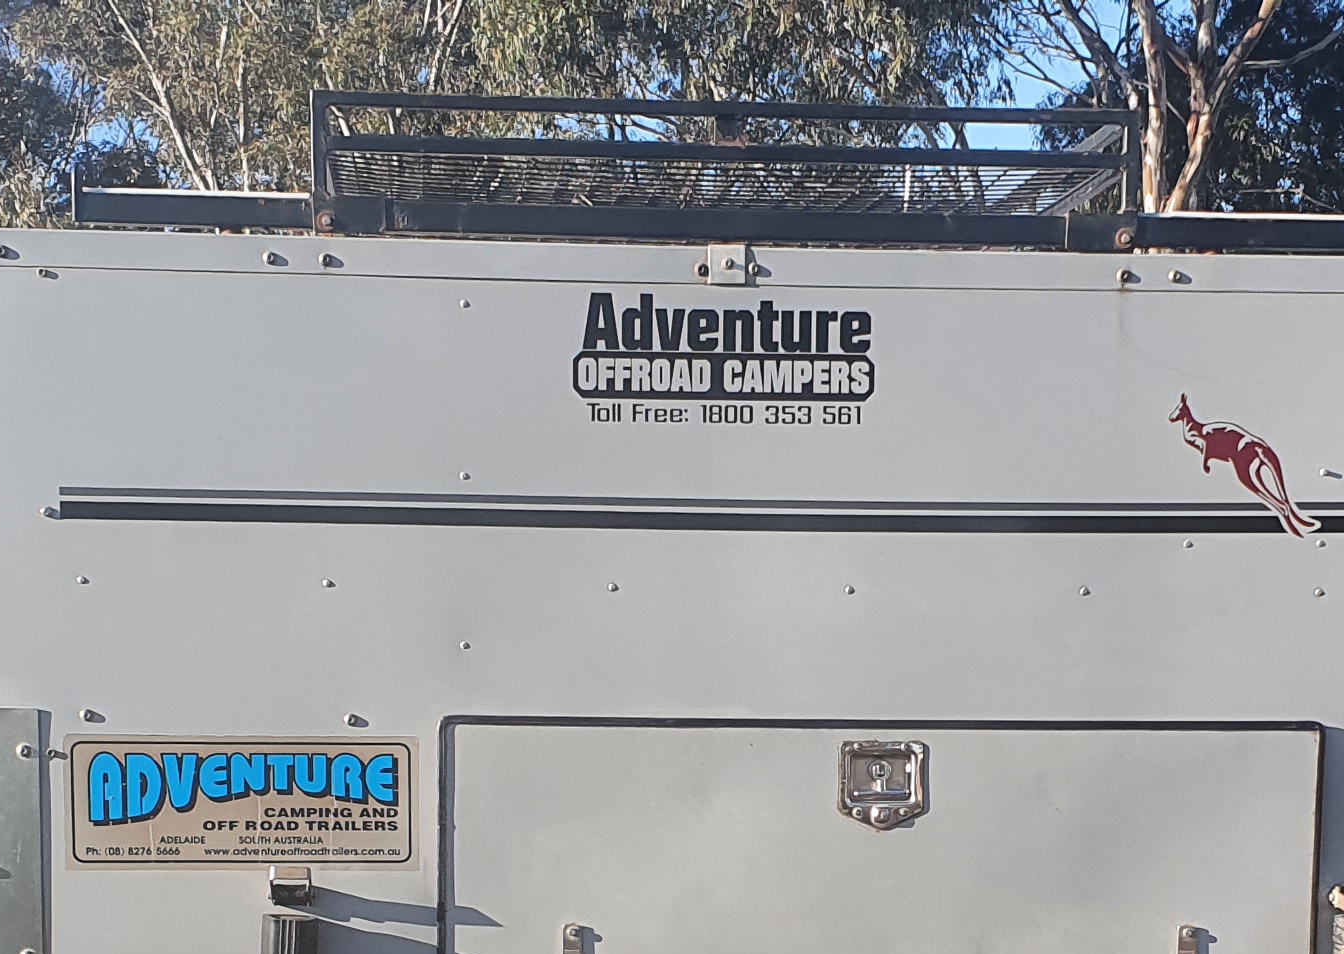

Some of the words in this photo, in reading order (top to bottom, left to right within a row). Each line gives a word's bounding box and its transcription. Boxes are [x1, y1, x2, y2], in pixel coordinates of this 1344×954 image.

[582, 292, 872, 354] Adventure
[577, 357, 712, 392] OFFROAD
[723, 359, 870, 395] CAMPERS
[586, 402, 622, 423] Toll
[632, 403, 689, 423] Free:
[700, 404, 754, 424] 1800
[764, 405, 812, 425] 353
[823, 405, 862, 425] 561
[88, 751, 400, 826] ADVENTURE
[263, 807, 353, 818] CAMPING
[358, 807, 399, 818] AND
[202, 820, 240, 831] OFF
[245, 820, 300, 831] ROAD
[304, 820, 399, 831] TRAILERS
[159, 836, 206, 844] ADELAIDE
[238, 836, 271, 844] SOUTH
[273, 836, 324, 844] AUSTRALIA
[104, 846, 125, 857] (08)
[127, 846, 153, 856] 8276
